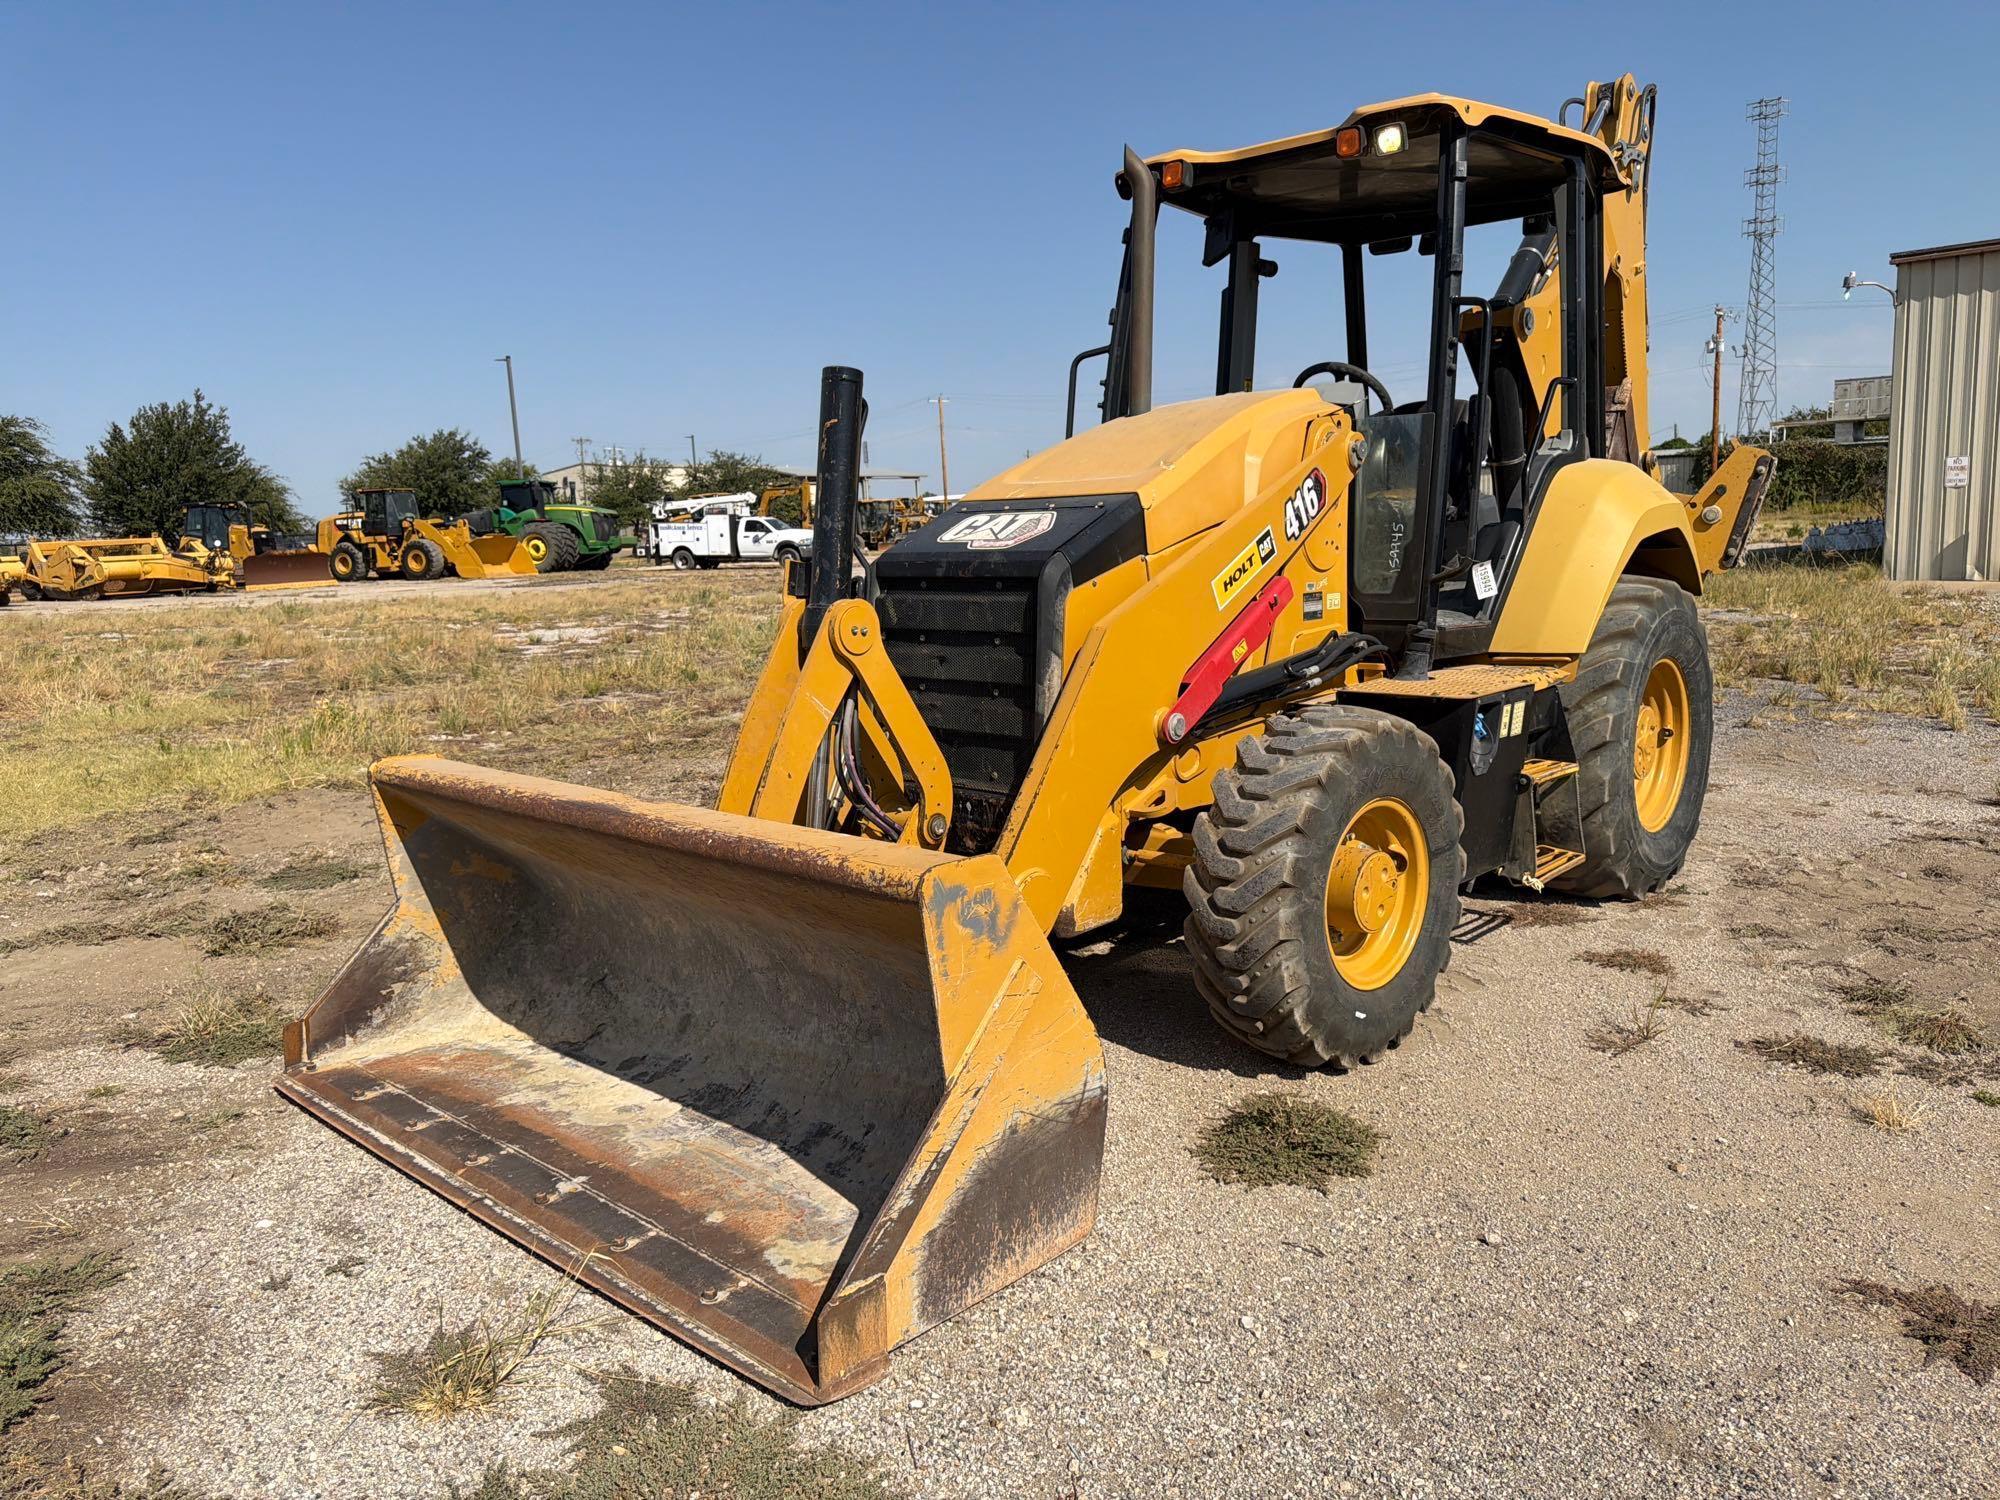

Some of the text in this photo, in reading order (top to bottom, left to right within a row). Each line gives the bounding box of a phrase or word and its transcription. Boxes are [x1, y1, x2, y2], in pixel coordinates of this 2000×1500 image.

[939, 512, 1043, 541] CAT
[1285, 477, 1319, 538] 416
[1223, 536, 1272, 593] HOLT CAT
[1389, 522, 1404, 573] 159945
[1480, 566, 1493, 593] 159945
